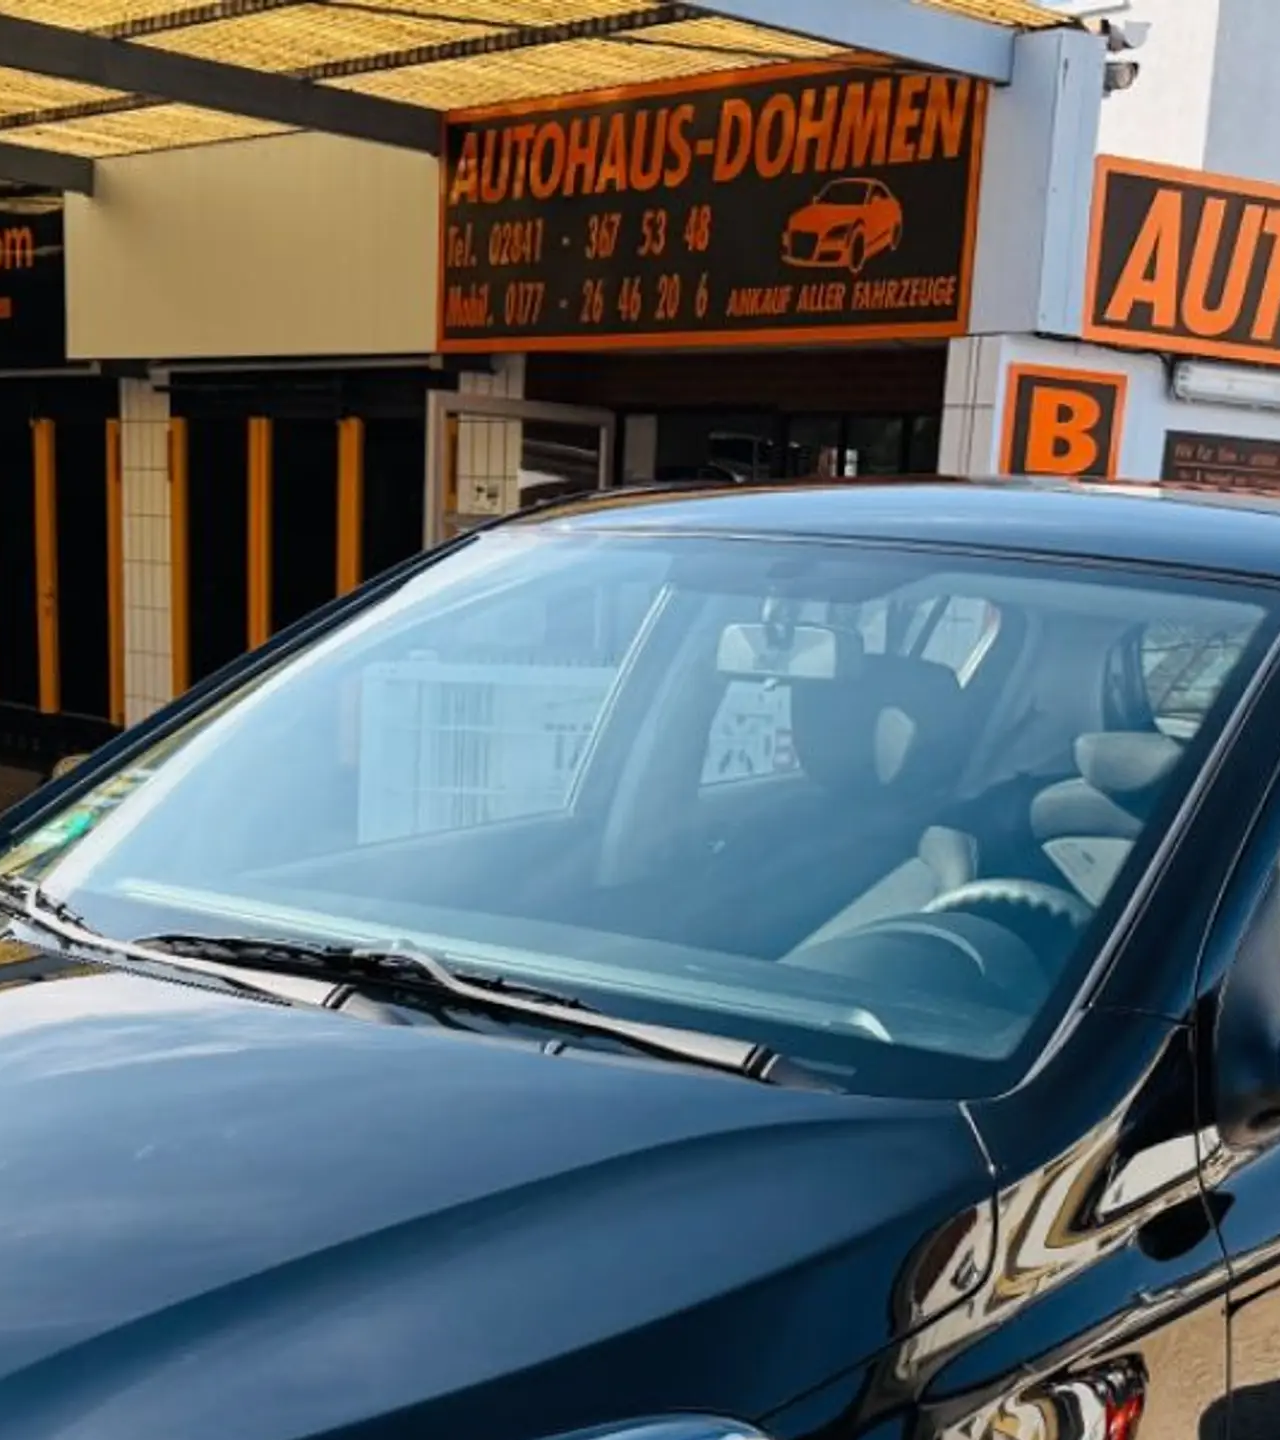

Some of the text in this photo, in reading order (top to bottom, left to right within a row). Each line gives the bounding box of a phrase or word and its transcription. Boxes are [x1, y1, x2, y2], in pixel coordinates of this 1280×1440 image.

[450, 74, 969, 205] AUTOHAUS-DOHMEN
[447, 222, 477, 268] Tel.
[488, 217, 544, 267] 02841
[585, 212, 622, 260] 367
[637, 207, 668, 257] 53
[684, 204, 712, 252] 48
[581, 277, 604, 325] 26
[618, 274, 643, 322] 46
[654, 272, 681, 320] 20
[694, 270, 710, 319] 6
[725, 274, 958, 318] ANKAUF ALLER FAHRZEUGE
[1024, 386, 1101, 475] B
